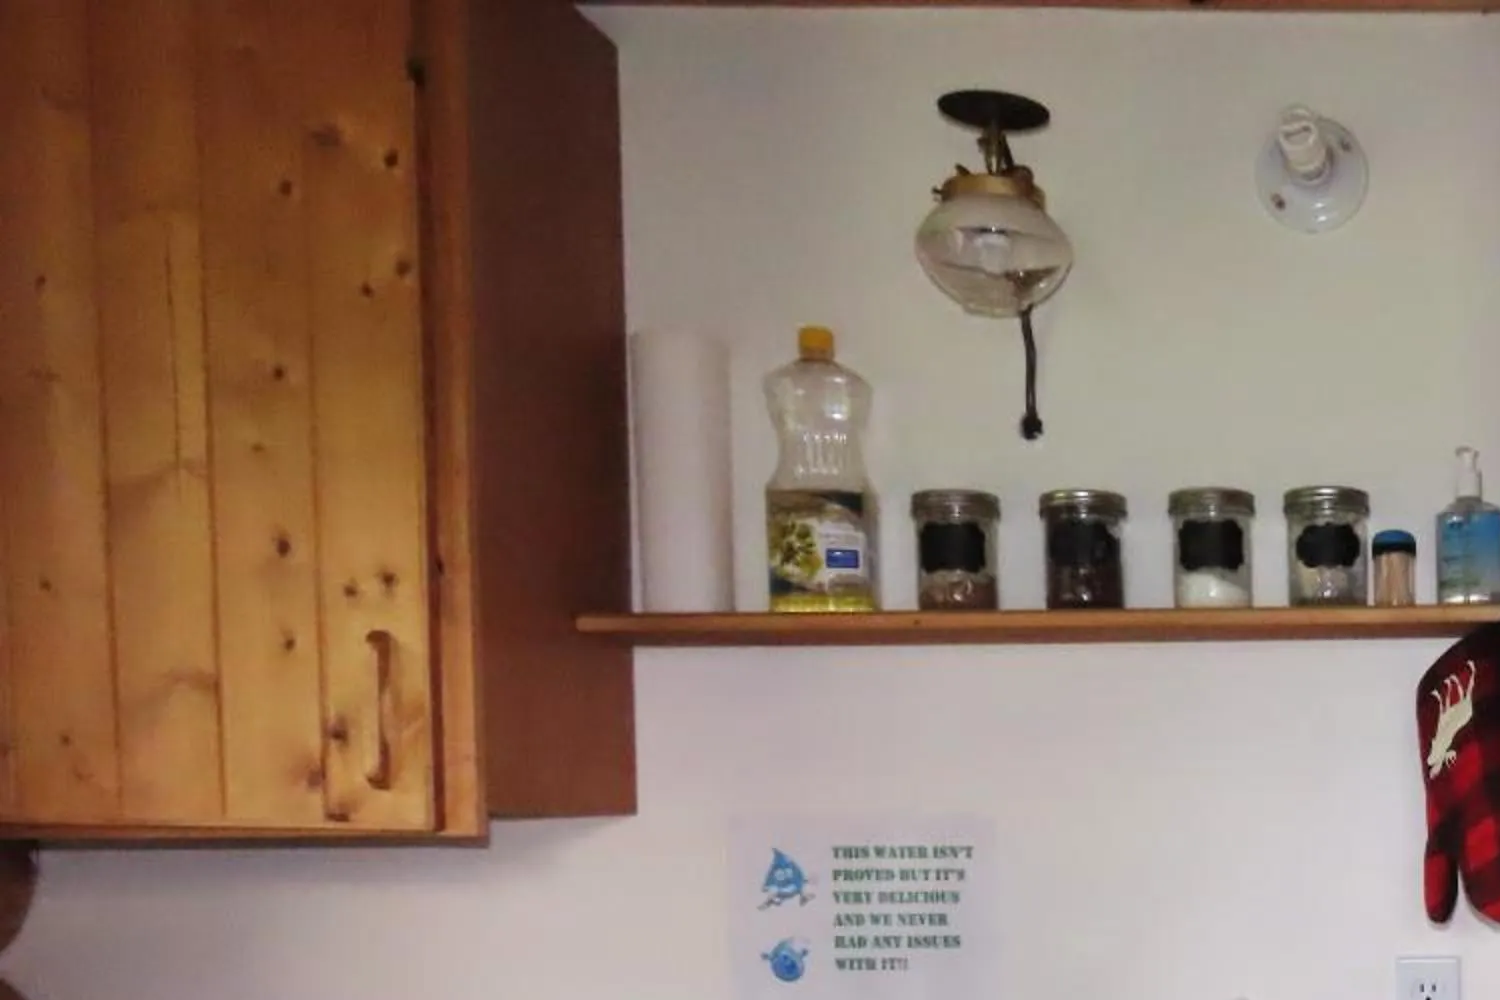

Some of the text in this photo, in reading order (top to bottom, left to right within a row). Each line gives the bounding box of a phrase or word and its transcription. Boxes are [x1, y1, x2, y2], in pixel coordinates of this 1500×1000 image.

[832, 845, 974, 859] THIS WATER ISN'T
[832, 869, 895, 881] PROVED
[899, 869, 931, 881] BUT
[832, 891, 960, 904] VERY DELICIOUS
[833, 913, 947, 926] AND WE NEVER
[834, 935, 961, 948] HAD ANY ISSUES
[834, 957, 877, 971] WITH
